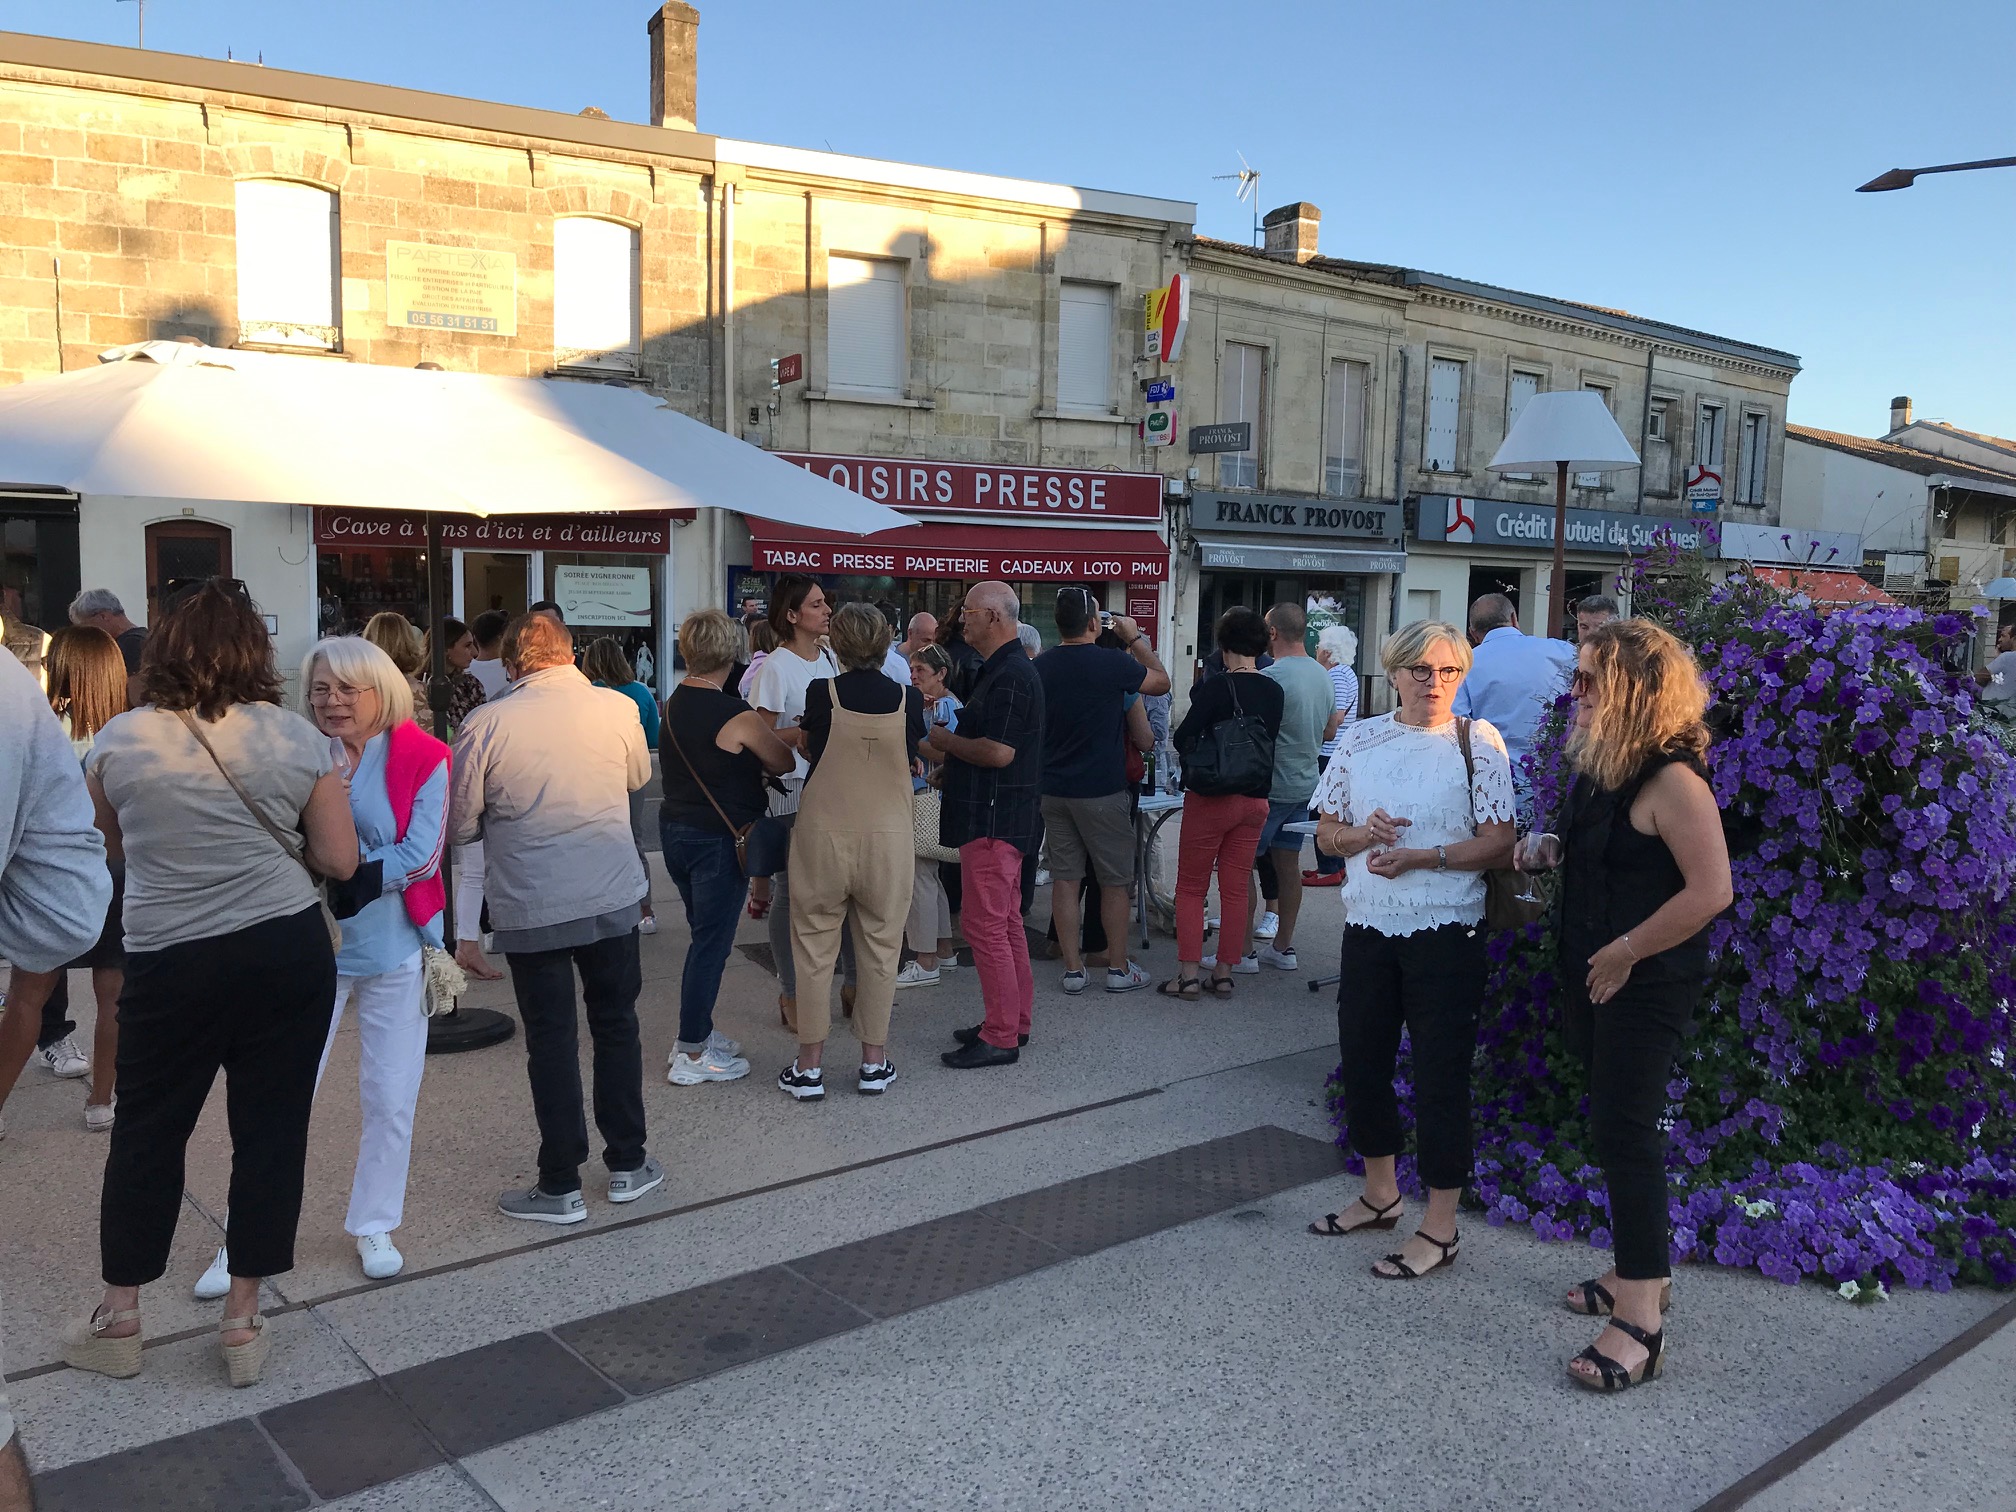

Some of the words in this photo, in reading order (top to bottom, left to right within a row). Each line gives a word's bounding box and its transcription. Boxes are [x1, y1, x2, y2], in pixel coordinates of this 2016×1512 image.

[417, 267, 450, 276] EXPERTISE
[451, 270, 488, 280] COMPTABLE
[423, 277, 464, 286] ENTREPRISES
[472, 281, 513, 291] PARTICULIERS
[423, 284, 450, 293] GESTION
[455, 296, 483, 304] AFFAIRES
[412, 312, 426, 324] 05
[430, 314, 444, 326] 56
[447, 316, 459, 327] 31
[464, 318, 477, 328] 51
[481, 319, 494, 330] 51
[1150, 385, 1160, 393] FDJ
[1199, 432, 1241, 445] PROVOST
[976, 472, 1106, 510] PRESSE
[1216, 500, 1297, 526] FRANCK
[1303, 506, 1386, 530] PROVOST
[332, 516, 391, 535] Cave
[399, 518, 414, 536] à
[476, 520, 525, 540] d'ici
[532, 524, 551, 541] et
[560, 524, 662, 544] d'ailleurs
[1496, 512, 1547, 540] Crédit
[1608, 521, 1628, 544] du
[763, 550, 821, 567] TABAC
[833, 553, 895, 570] PRESSE
[905, 556, 989, 573] PAPETERIE
[1000, 559, 1074, 576] CADEAUX
[1083, 562, 1122, 576] LOTO
[1132, 562, 1163, 577] PMU
[1208, 554, 1245, 564] PROVOST
[1292, 558, 1326, 567] PROVOST
[1370, 561, 1400, 570] PROVOST
[564, 571, 589, 579] SOIRÉE
[590, 572, 635, 580] VIGNERONNE
[1133, 972, 1141, 982] N
